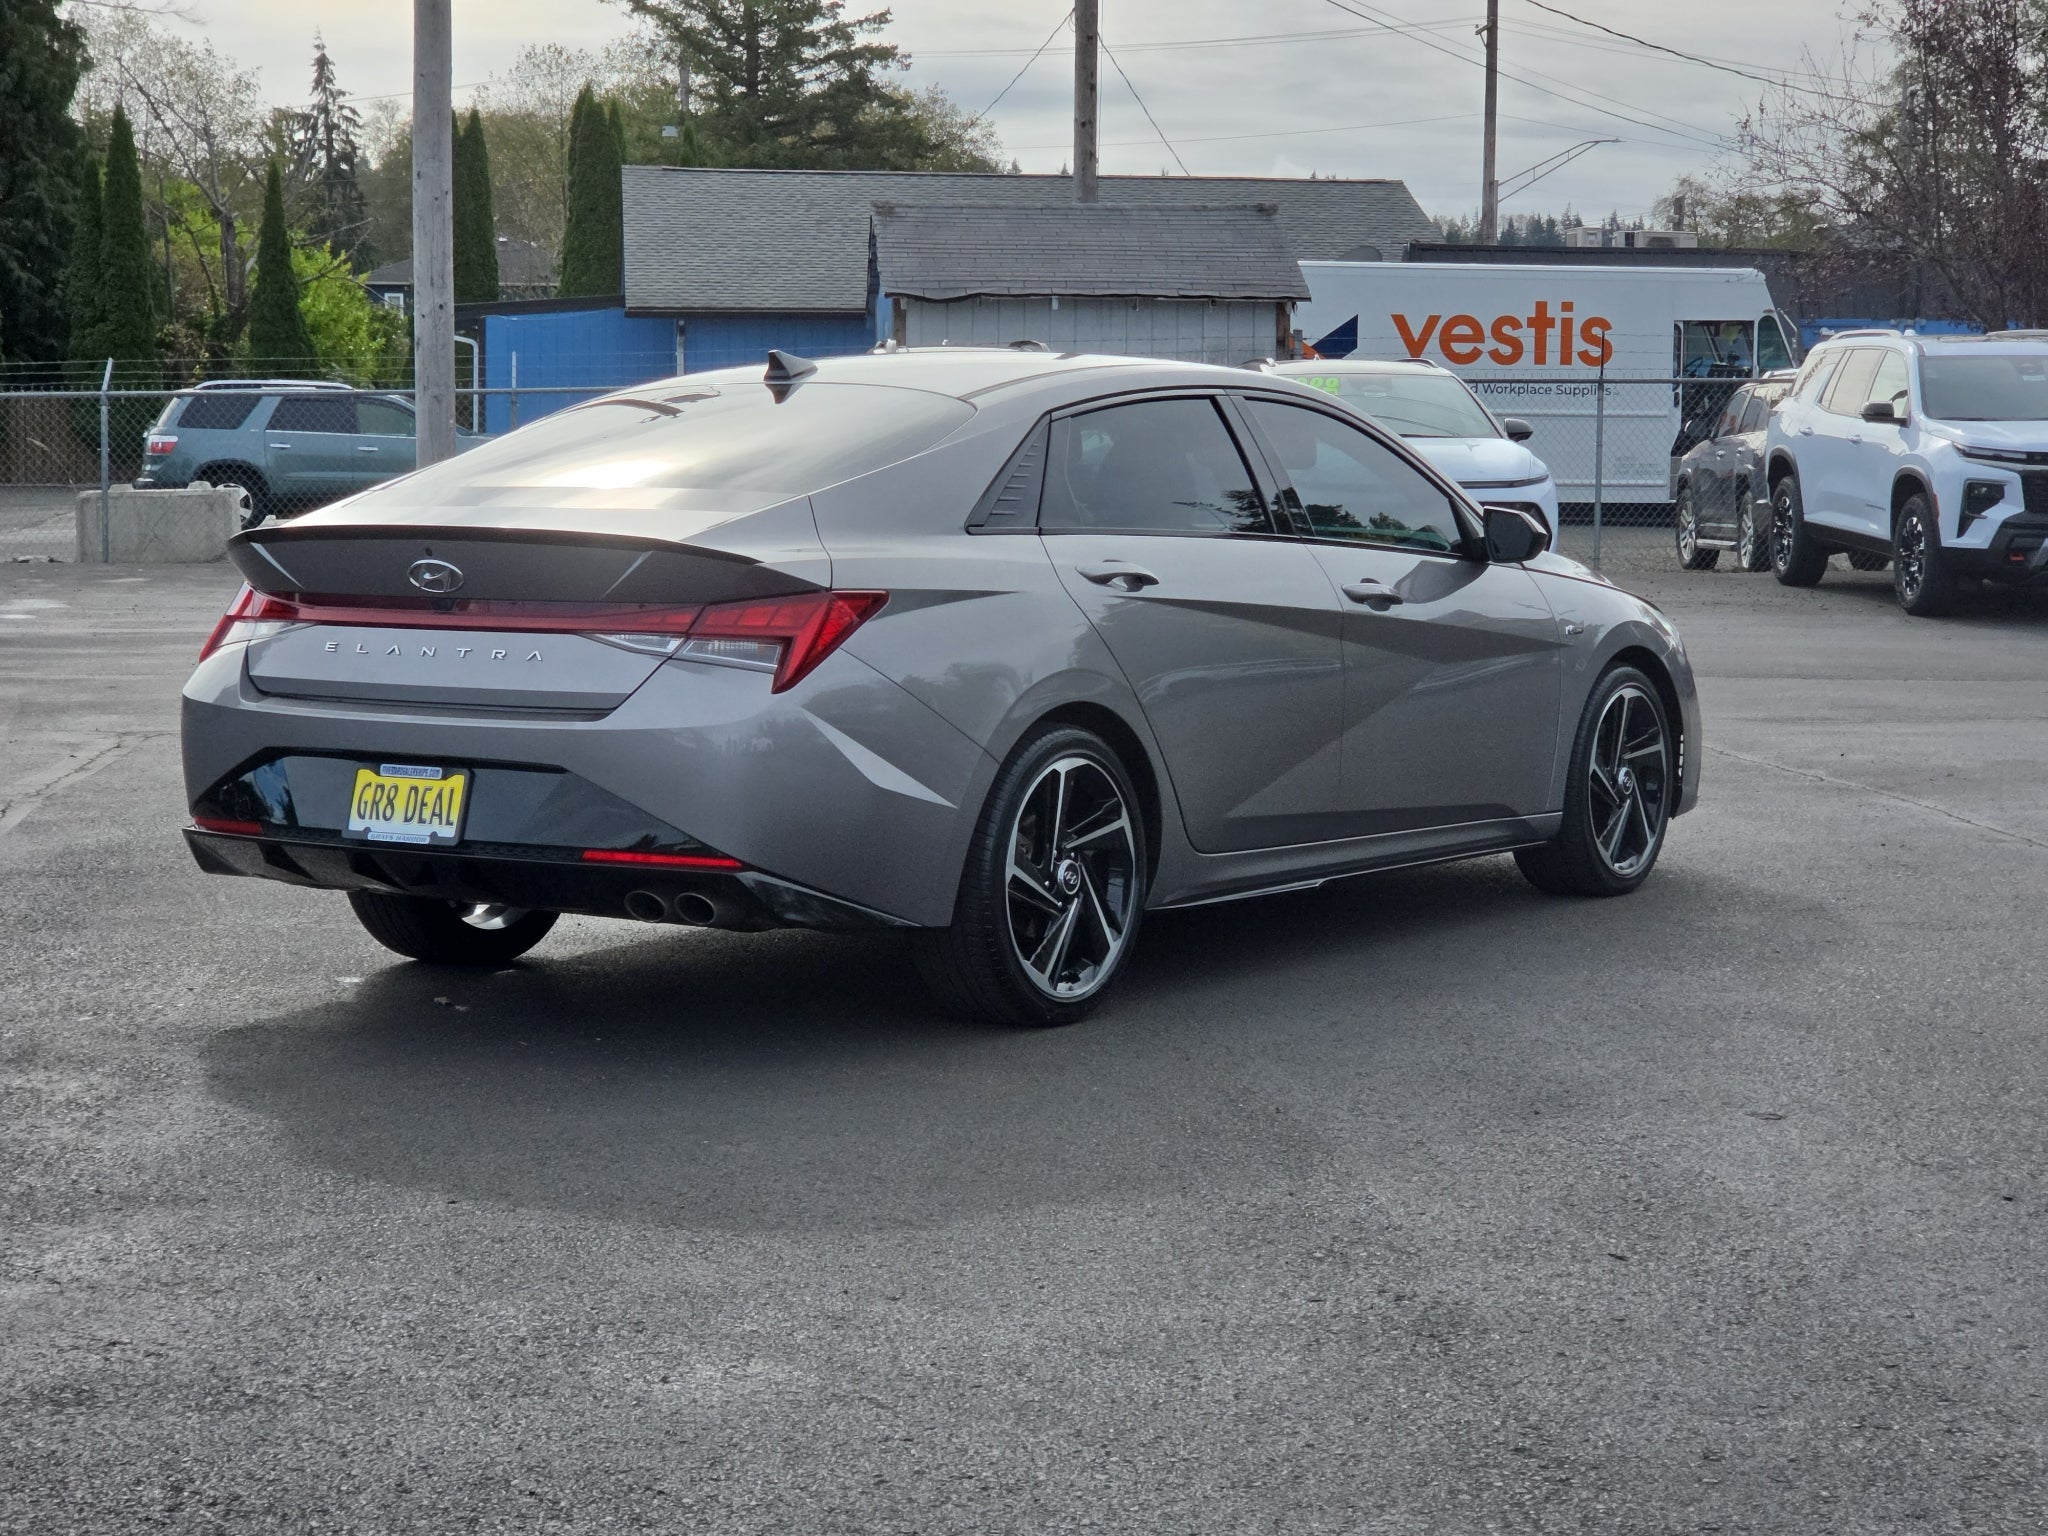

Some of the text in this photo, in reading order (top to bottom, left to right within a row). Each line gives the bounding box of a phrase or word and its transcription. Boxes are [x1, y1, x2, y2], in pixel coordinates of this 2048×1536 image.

[1390, 301, 1613, 367] vestis
[1482, 383, 1552, 396] Workplace
[1556, 384, 1612, 398] Supplis
[325, 641, 542, 661] ELANTRA
[357, 782, 454, 825] GR8 DEAL
